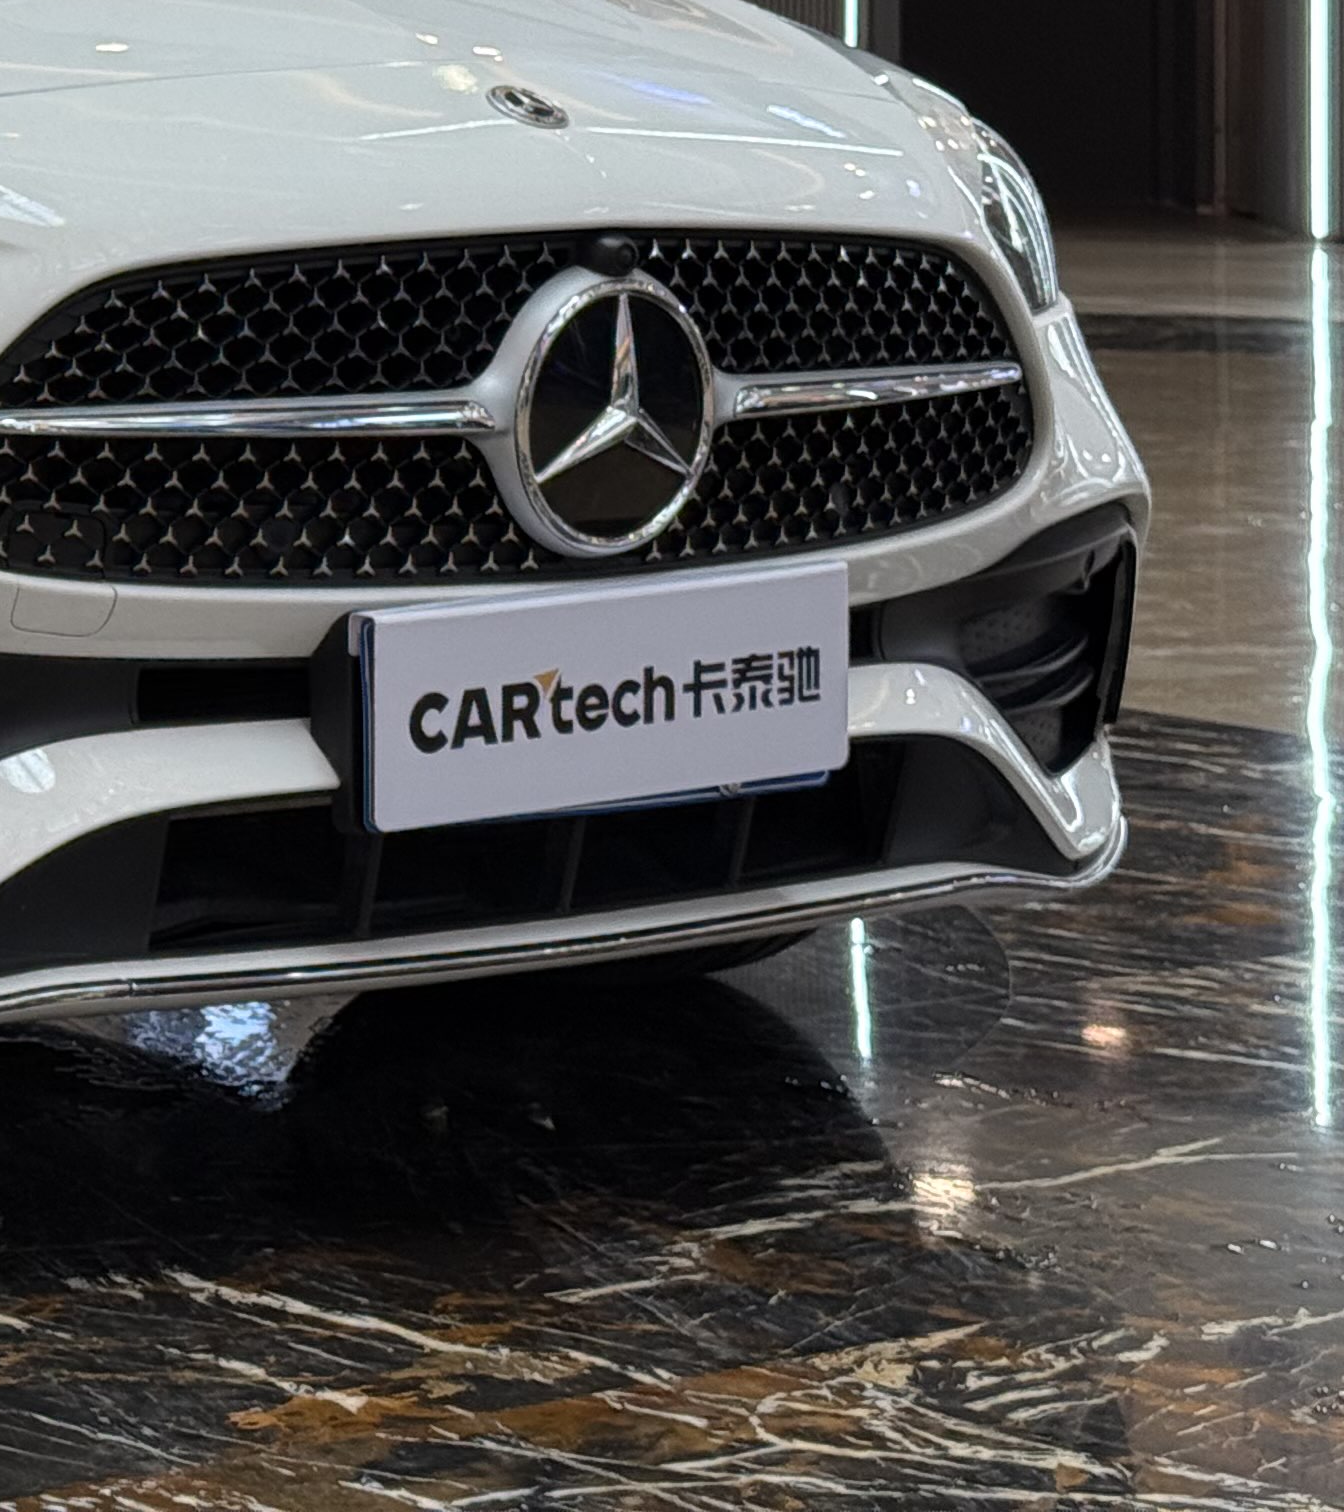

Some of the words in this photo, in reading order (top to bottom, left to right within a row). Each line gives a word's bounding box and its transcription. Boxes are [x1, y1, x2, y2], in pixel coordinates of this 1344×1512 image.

[408, 665, 676, 755] CARtech
[683, 645, 821, 720] 卡泰驰
